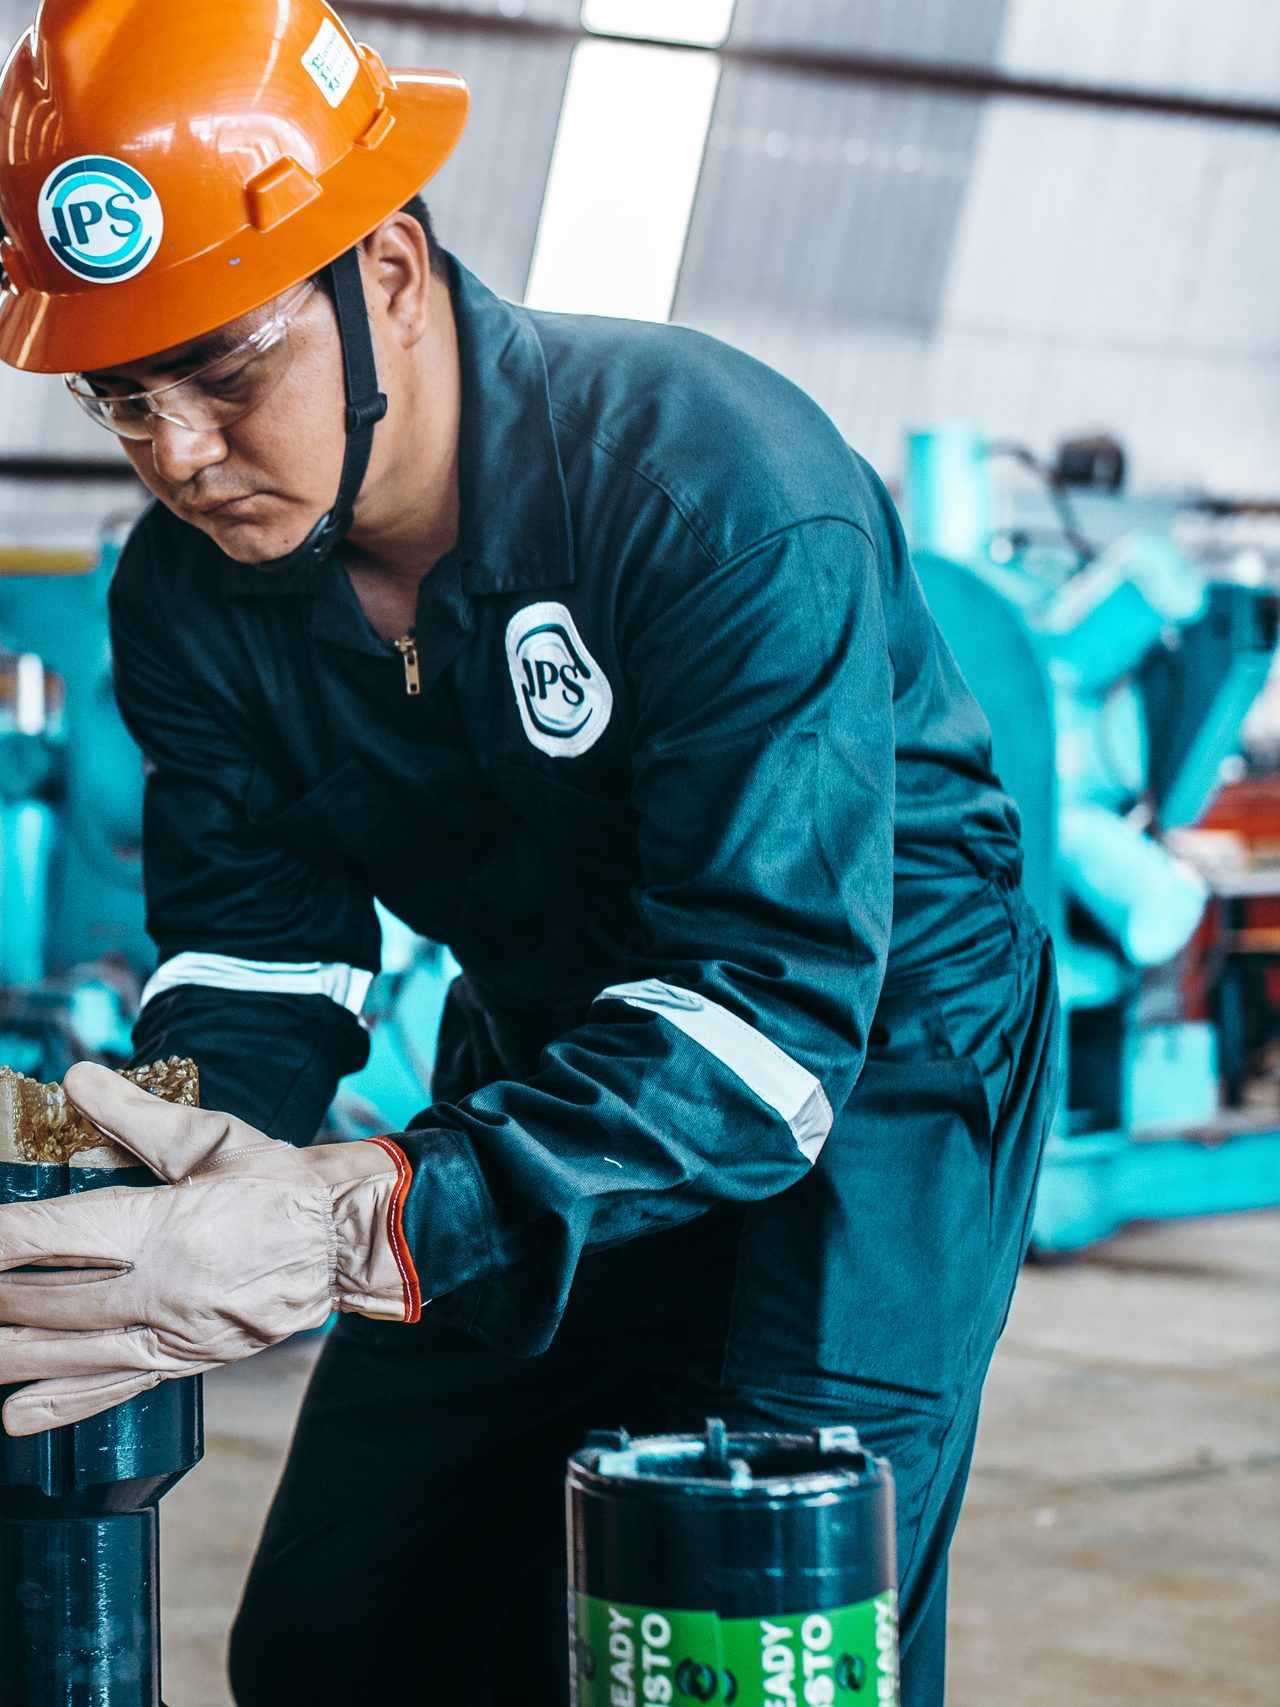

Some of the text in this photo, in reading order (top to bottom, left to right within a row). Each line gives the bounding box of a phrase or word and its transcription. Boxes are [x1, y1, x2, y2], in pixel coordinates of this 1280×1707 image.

[49, 193, 143, 247] JPS
[521, 657, 585, 706] JPS
[608, 1606, 635, 1707] EADY
